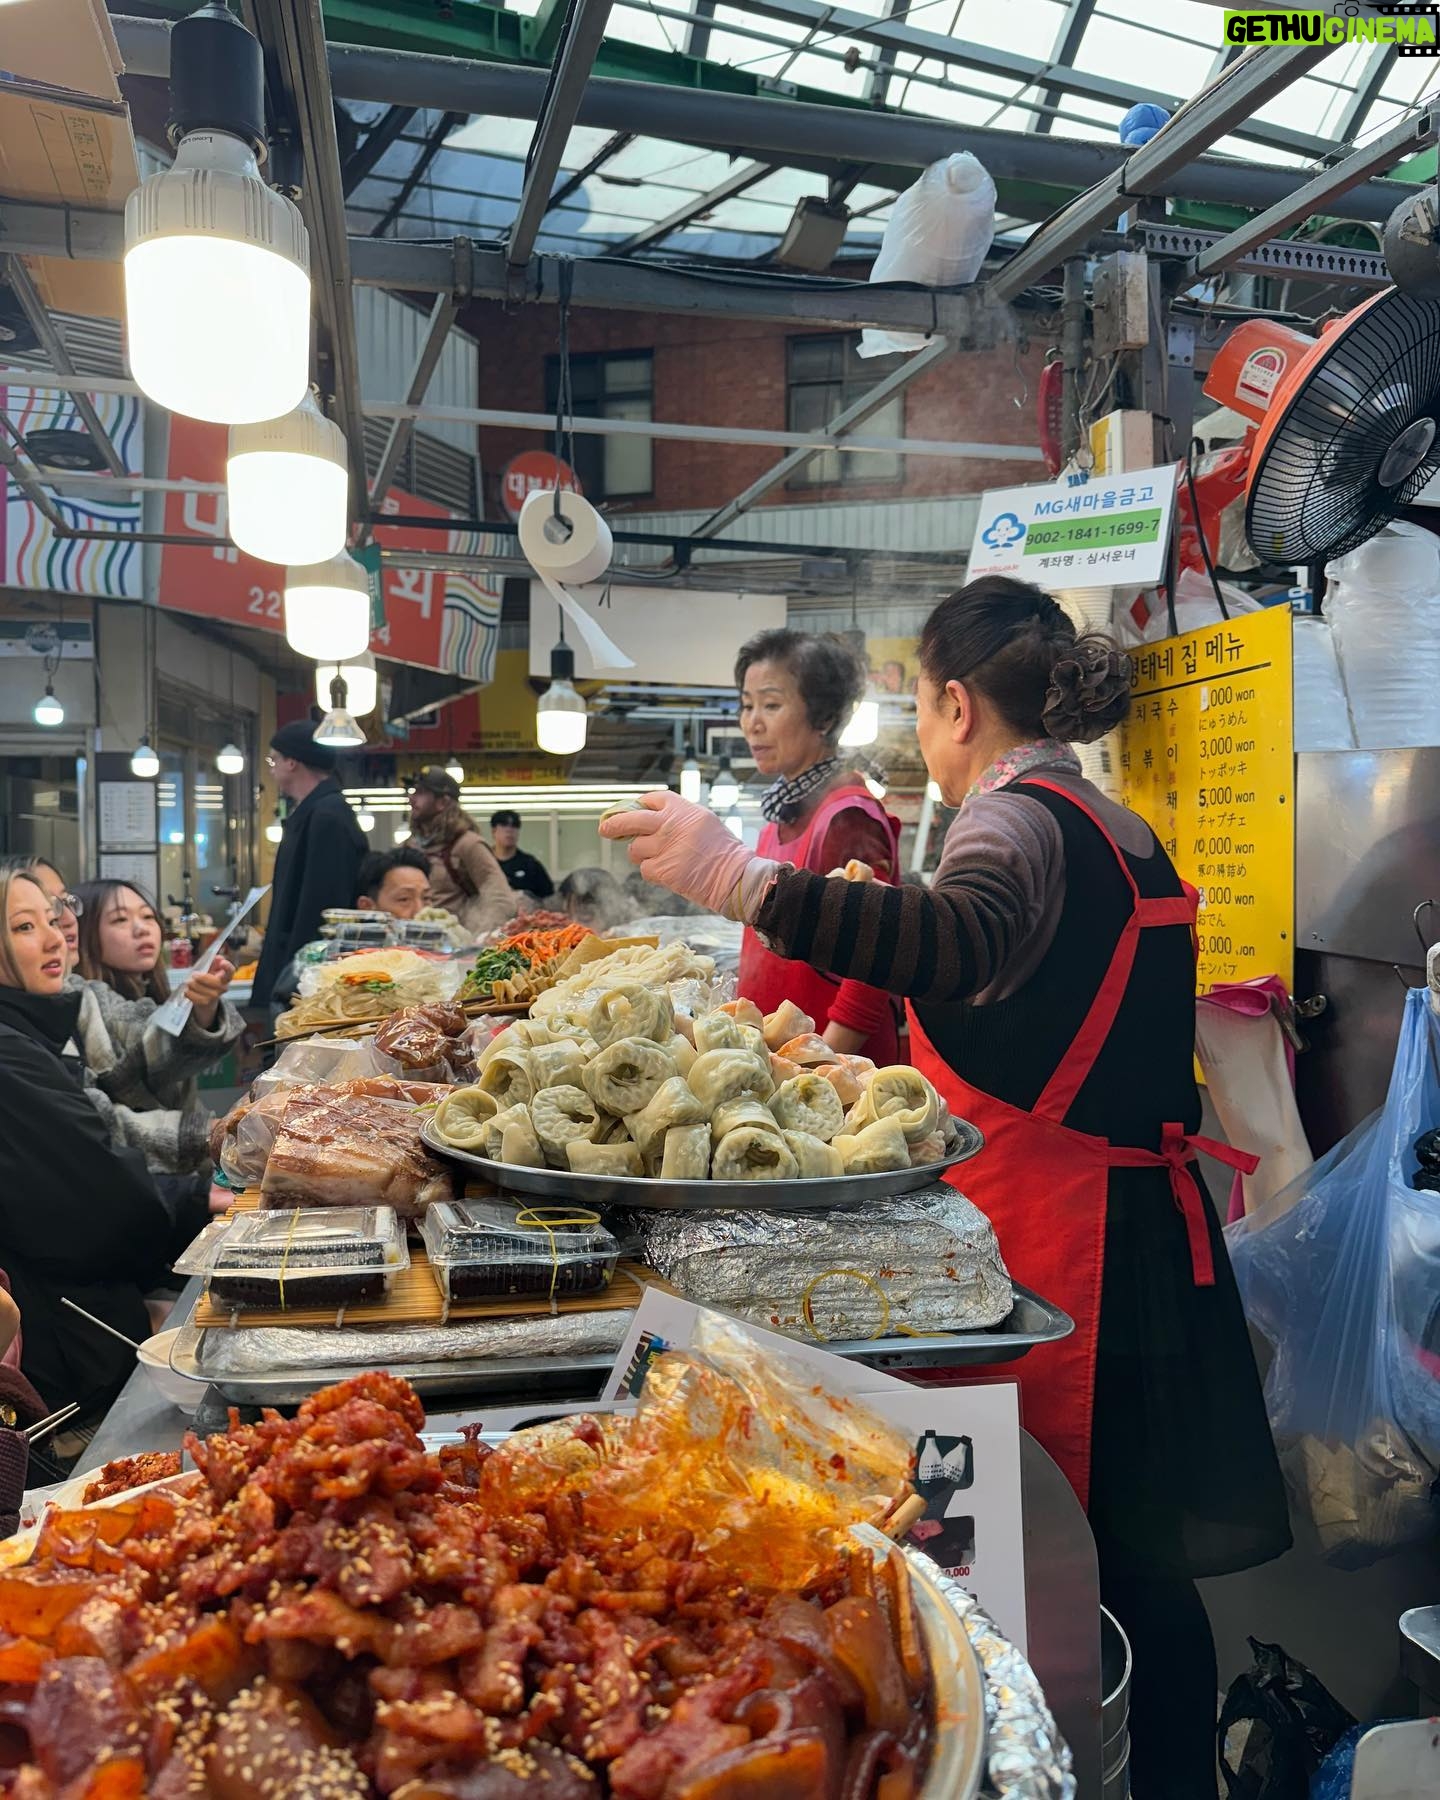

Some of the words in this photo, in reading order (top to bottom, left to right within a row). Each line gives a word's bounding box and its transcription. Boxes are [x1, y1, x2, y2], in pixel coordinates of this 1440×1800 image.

[1034, 486, 1154, 516] MG새마을금고
[1025, 518, 1161, 546] 9002-1841-1699-7
[1038, 554, 1075, 569] 계좌명
[1181, 639, 1198, 676] 집
[1205, 632, 1245, 665] 메뉴
[1235, 688, 1255, 702] won
[1199, 710, 1248, 732] にゅうめん
[1199, 736, 1233, 760] 3,000
[1235, 739, 1256, 752] won
[1199, 786, 1232, 808] 5,000
[1235, 791, 1256, 804] won
[1193, 836, 1232, 858] 10,000
[1235, 843, 1255, 855] won
[1234, 894, 1255, 906] won
[1197, 912, 1226, 928] おでん
[1198, 934, 1232, 956] 3,000
